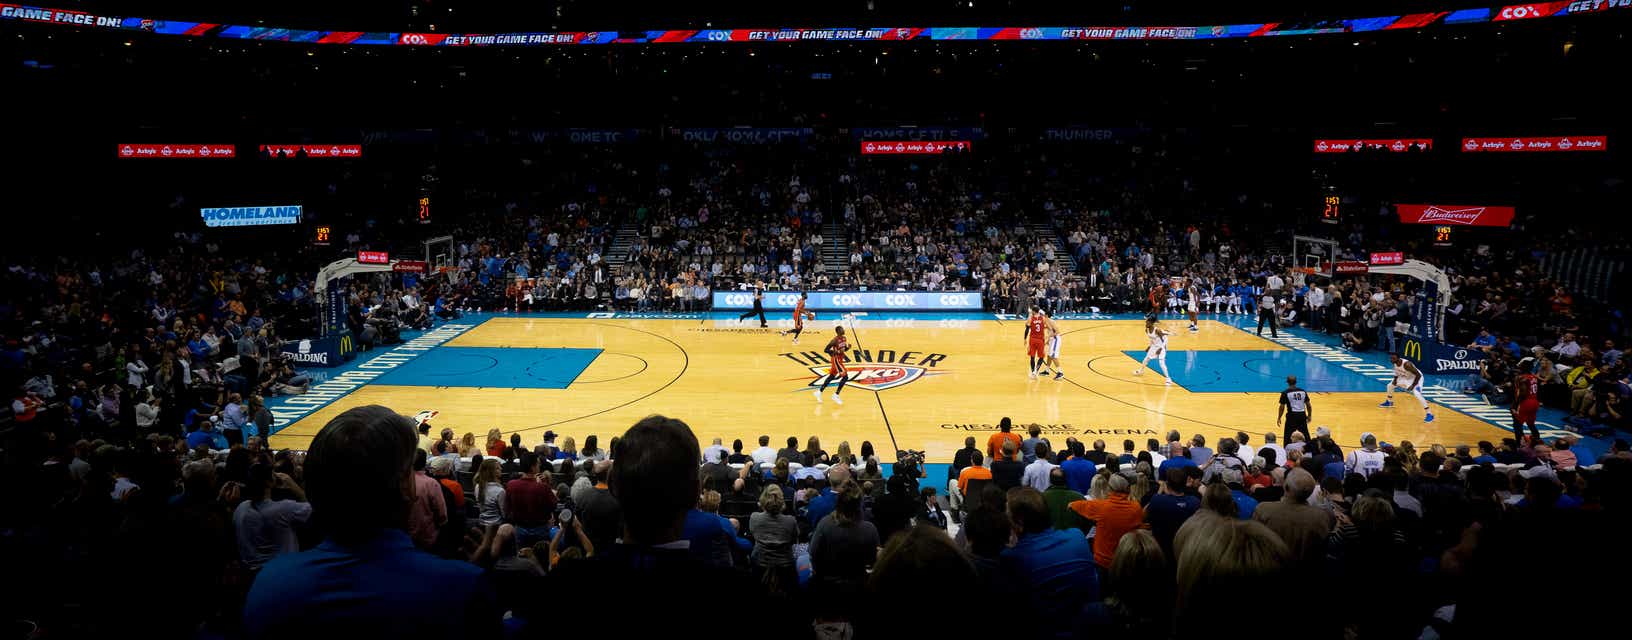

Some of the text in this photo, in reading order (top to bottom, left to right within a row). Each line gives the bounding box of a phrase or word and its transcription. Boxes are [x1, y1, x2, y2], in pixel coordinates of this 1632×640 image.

[2, 7, 122, 28] GAME FACE ON!
[707, 31, 732, 41] COX
[748, 31, 773, 40] GET
[773, 31, 800, 40] YOUR
[801, 31, 834, 40] GAME
[835, 30, 864, 40] FACE
[1061, 29, 1082, 38] GET
[1084, 29, 1113, 38] YOUR
[1114, 28, 1143, 38] GAME
[1145, 28, 1175, 38] FACE
[444, 36, 467, 45] GET
[468, 35, 495, 44] YOUR
[496, 35, 527, 44] GAME
[528, 34, 555, 43] FACE
[1482, 139, 1602, 149] Arby's Arby's Arby's
[203, 207, 299, 221] HOMELAND
[420, 205, 429, 219] 21
[1325, 204, 1338, 218] 21
[1424, 209, 1478, 220] Budweiser
[317, 233, 328, 241] 21
[1437, 233, 1449, 241] 21
[724, 294, 754, 306] COX
[832, 294, 865, 306] COX
[885, 294, 918, 306] COX
[940, 294, 973, 306] COX
[1034, 324, 1041, 332] 3
[1436, 359, 1489, 371] SPALDIN
[268, 370, 386, 427] OKLAHOMA
[357, 352, 419, 369] CITY
